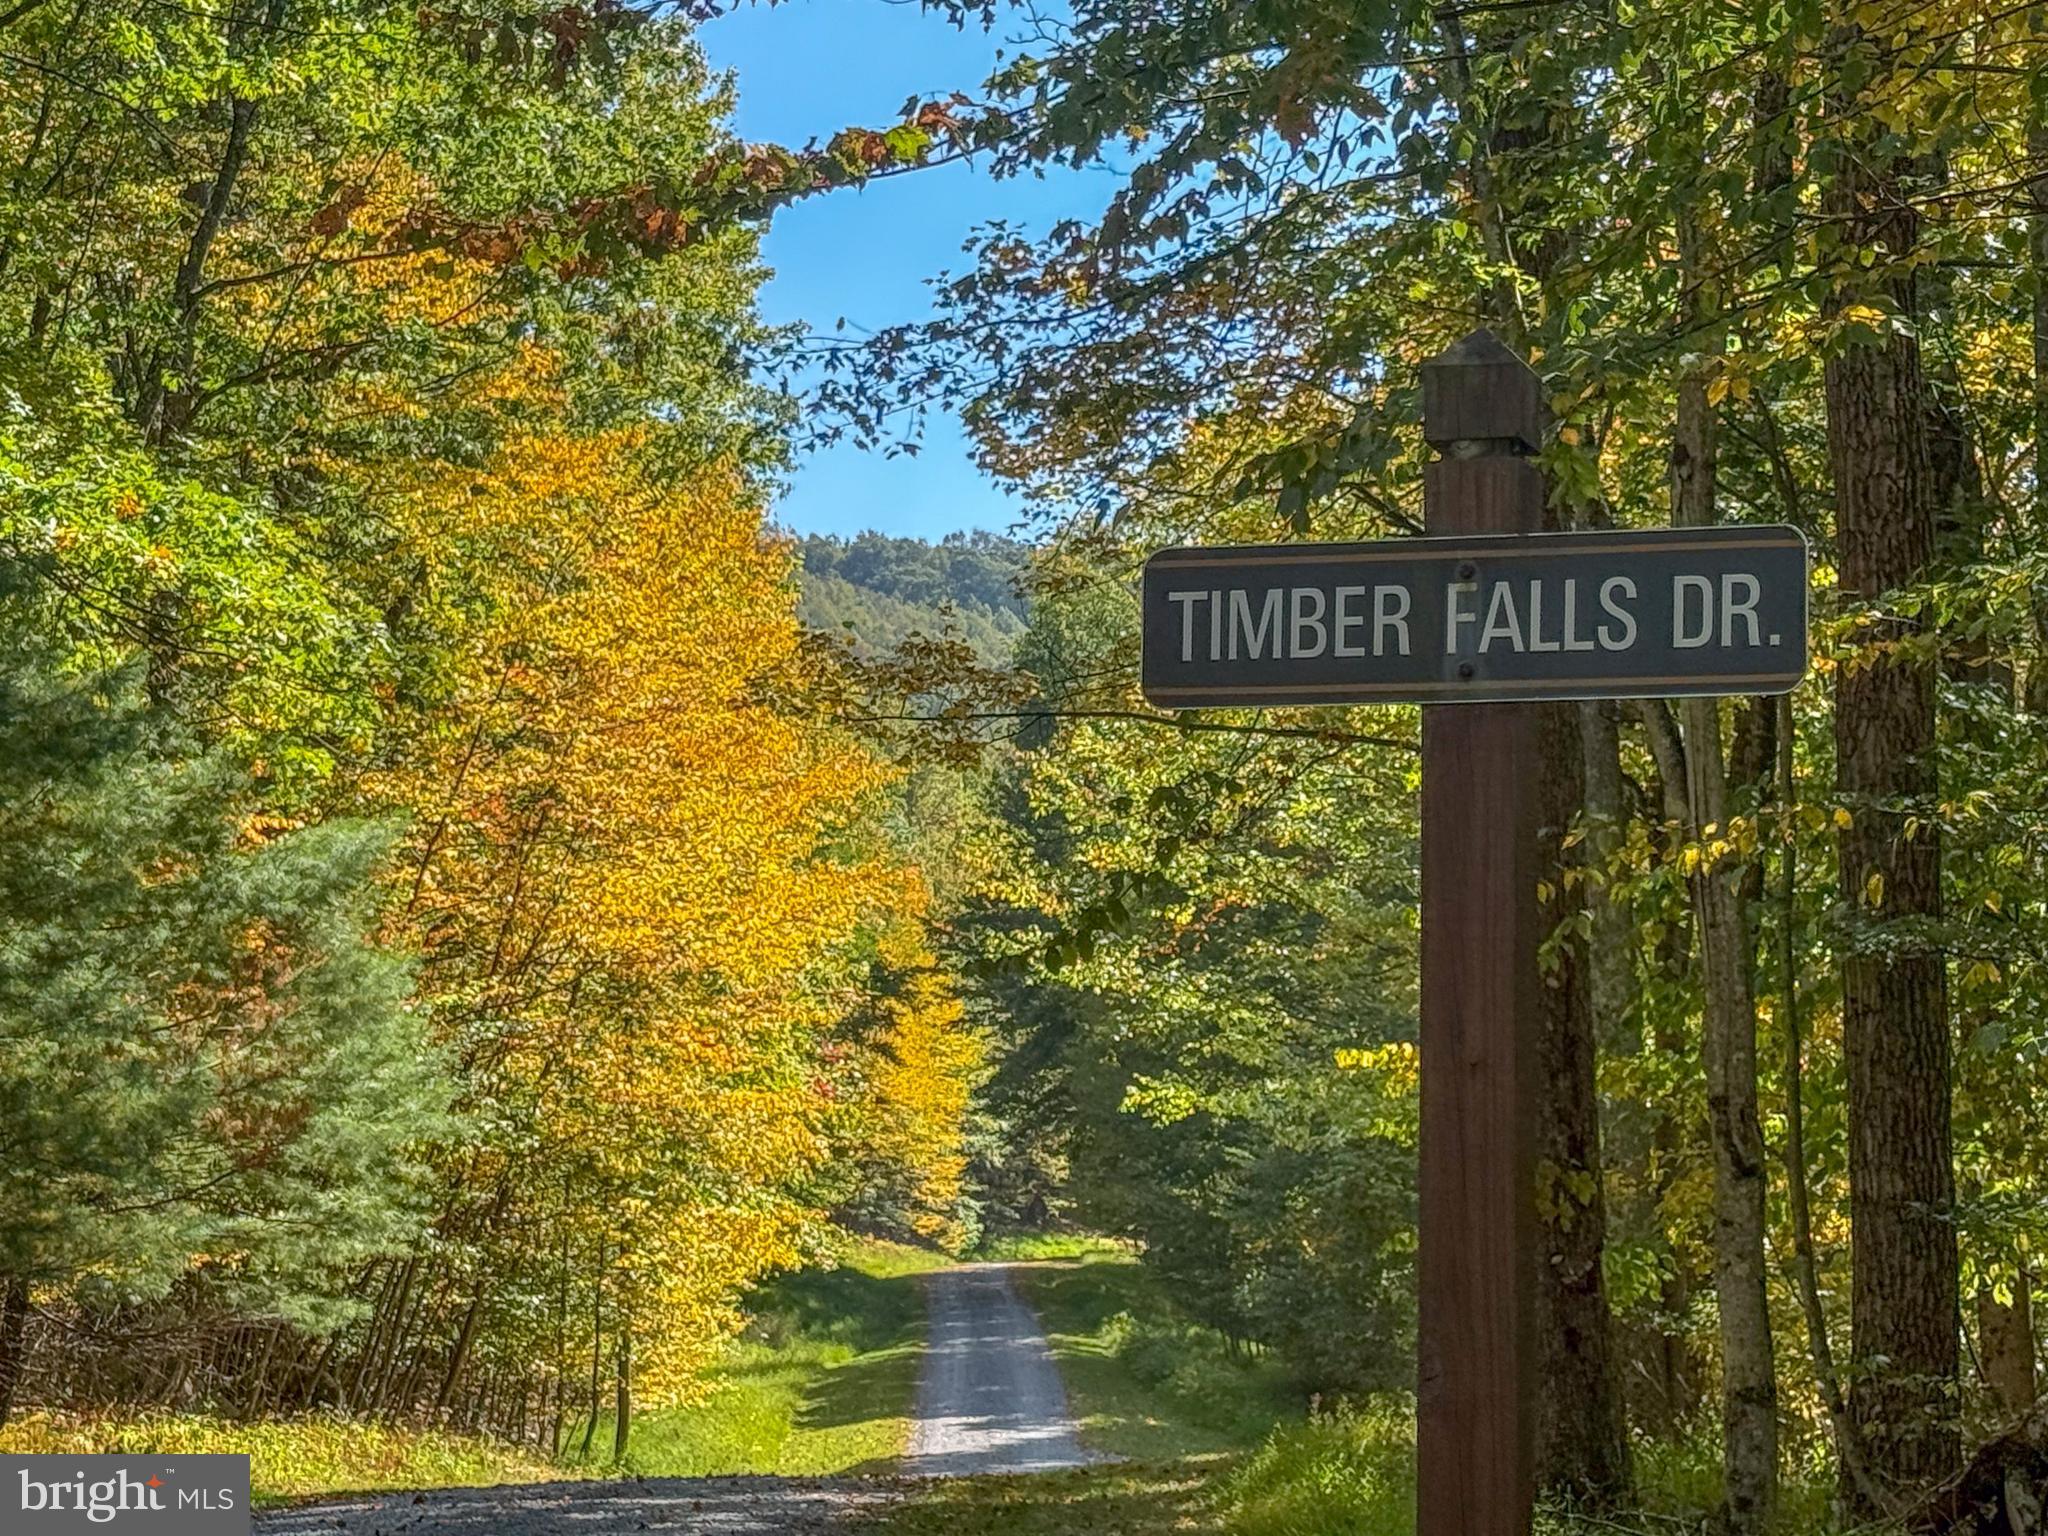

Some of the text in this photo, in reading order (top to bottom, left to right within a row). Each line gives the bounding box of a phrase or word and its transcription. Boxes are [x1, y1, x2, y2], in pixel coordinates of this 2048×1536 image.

[1167, 573, 1782, 663] TIMBER FALLS DR.
